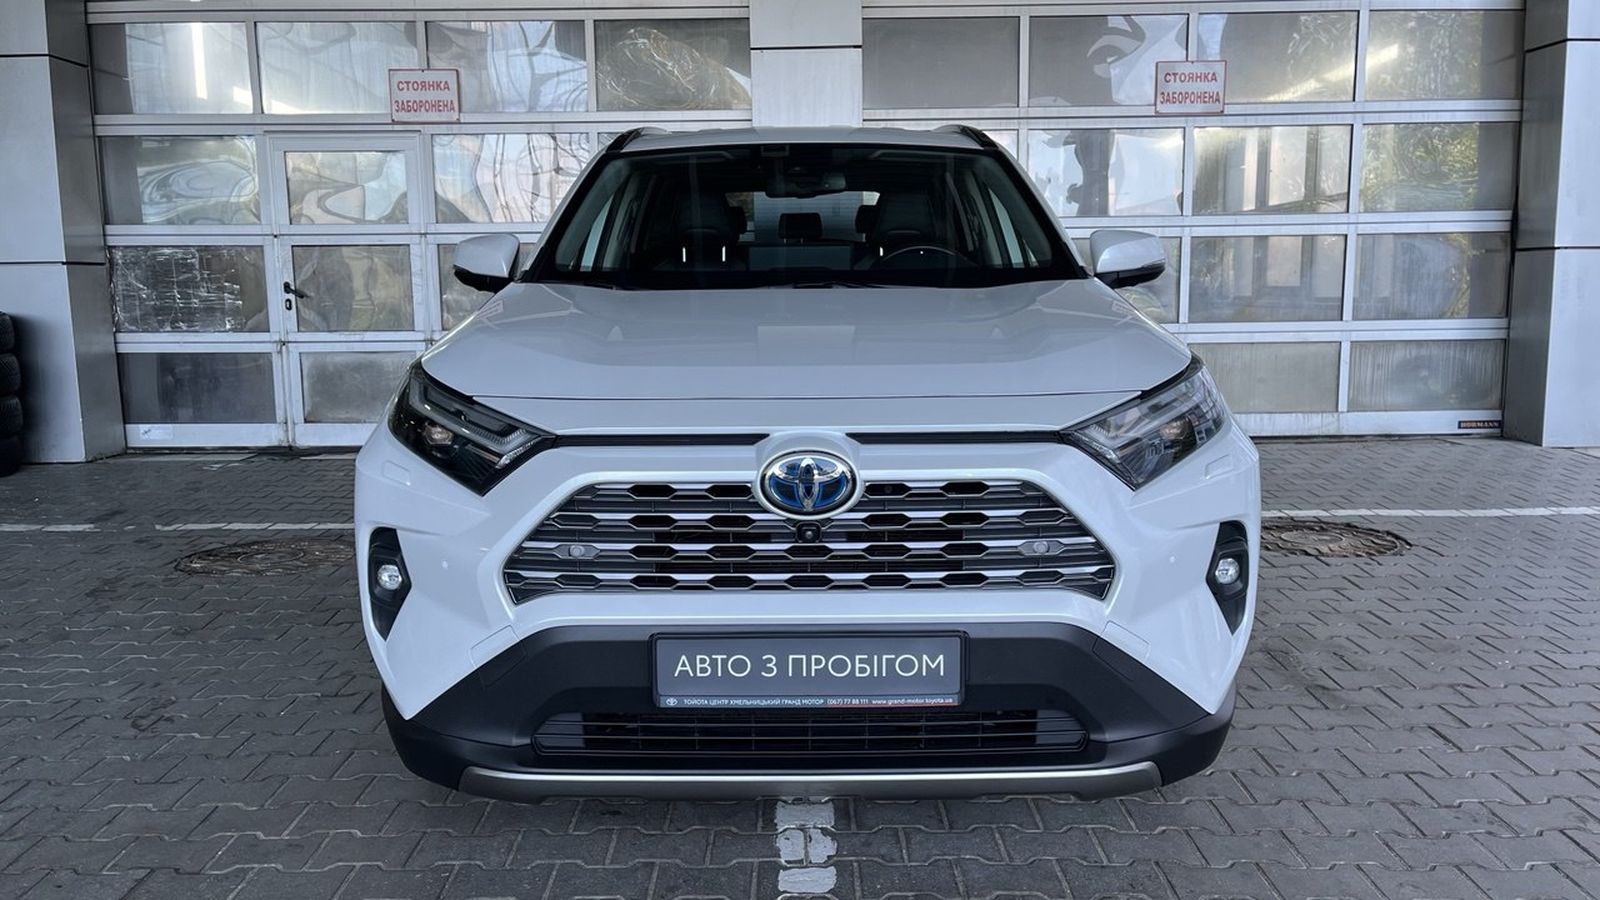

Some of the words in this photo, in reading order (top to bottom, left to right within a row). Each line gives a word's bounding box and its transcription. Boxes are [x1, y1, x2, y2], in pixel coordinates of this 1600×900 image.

[1164, 72, 1218, 83] СТОЯНКА
[396, 80, 450, 92] СТОЯНКА
[1160, 91, 1221, 105] ЗАБОРОНЕНА
[394, 99, 456, 113] ЗАБОРОНЕНА
[674, 654, 751, 677] АВТО
[761, 654, 777, 677] З
[788, 654, 944, 677] ПРОБІГОМ
[683, 698, 708, 706] ТОЙОТА
[709, 698, 729, 706] ЦЕНТР
[730, 698, 781, 706] ХМЕЛЬНИЦЬКИЙ
[781, 698, 801, 706] ГРАНД
